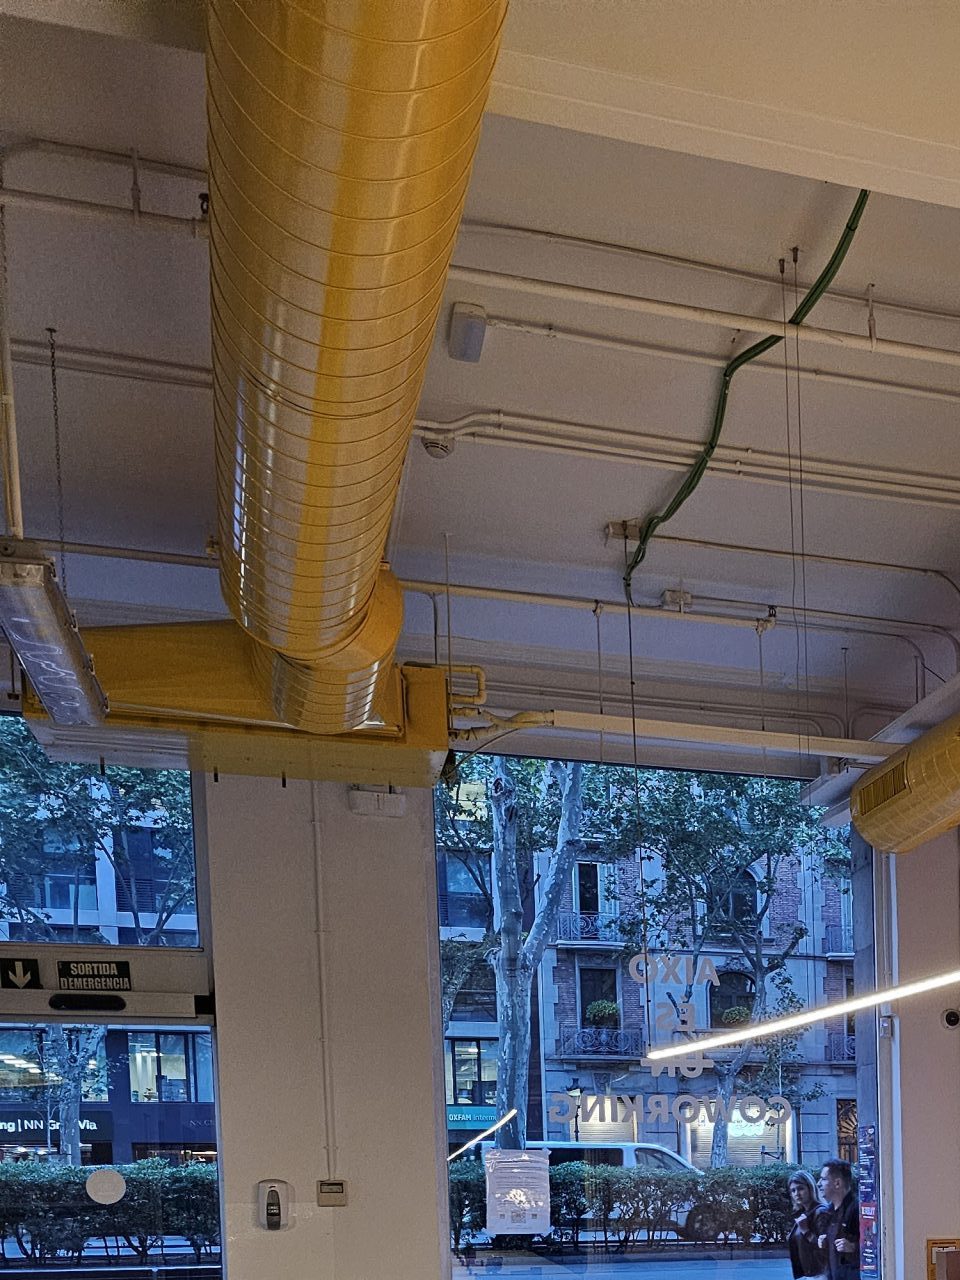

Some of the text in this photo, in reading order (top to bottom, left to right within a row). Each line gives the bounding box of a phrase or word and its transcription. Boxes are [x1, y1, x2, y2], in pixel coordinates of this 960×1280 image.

[70, 962, 118, 976] SORTIDA
[448, 1113, 472, 1121] OXFAM
[24, 1119, 44, 1130] NN
[78, 1119, 97, 1130] Via
